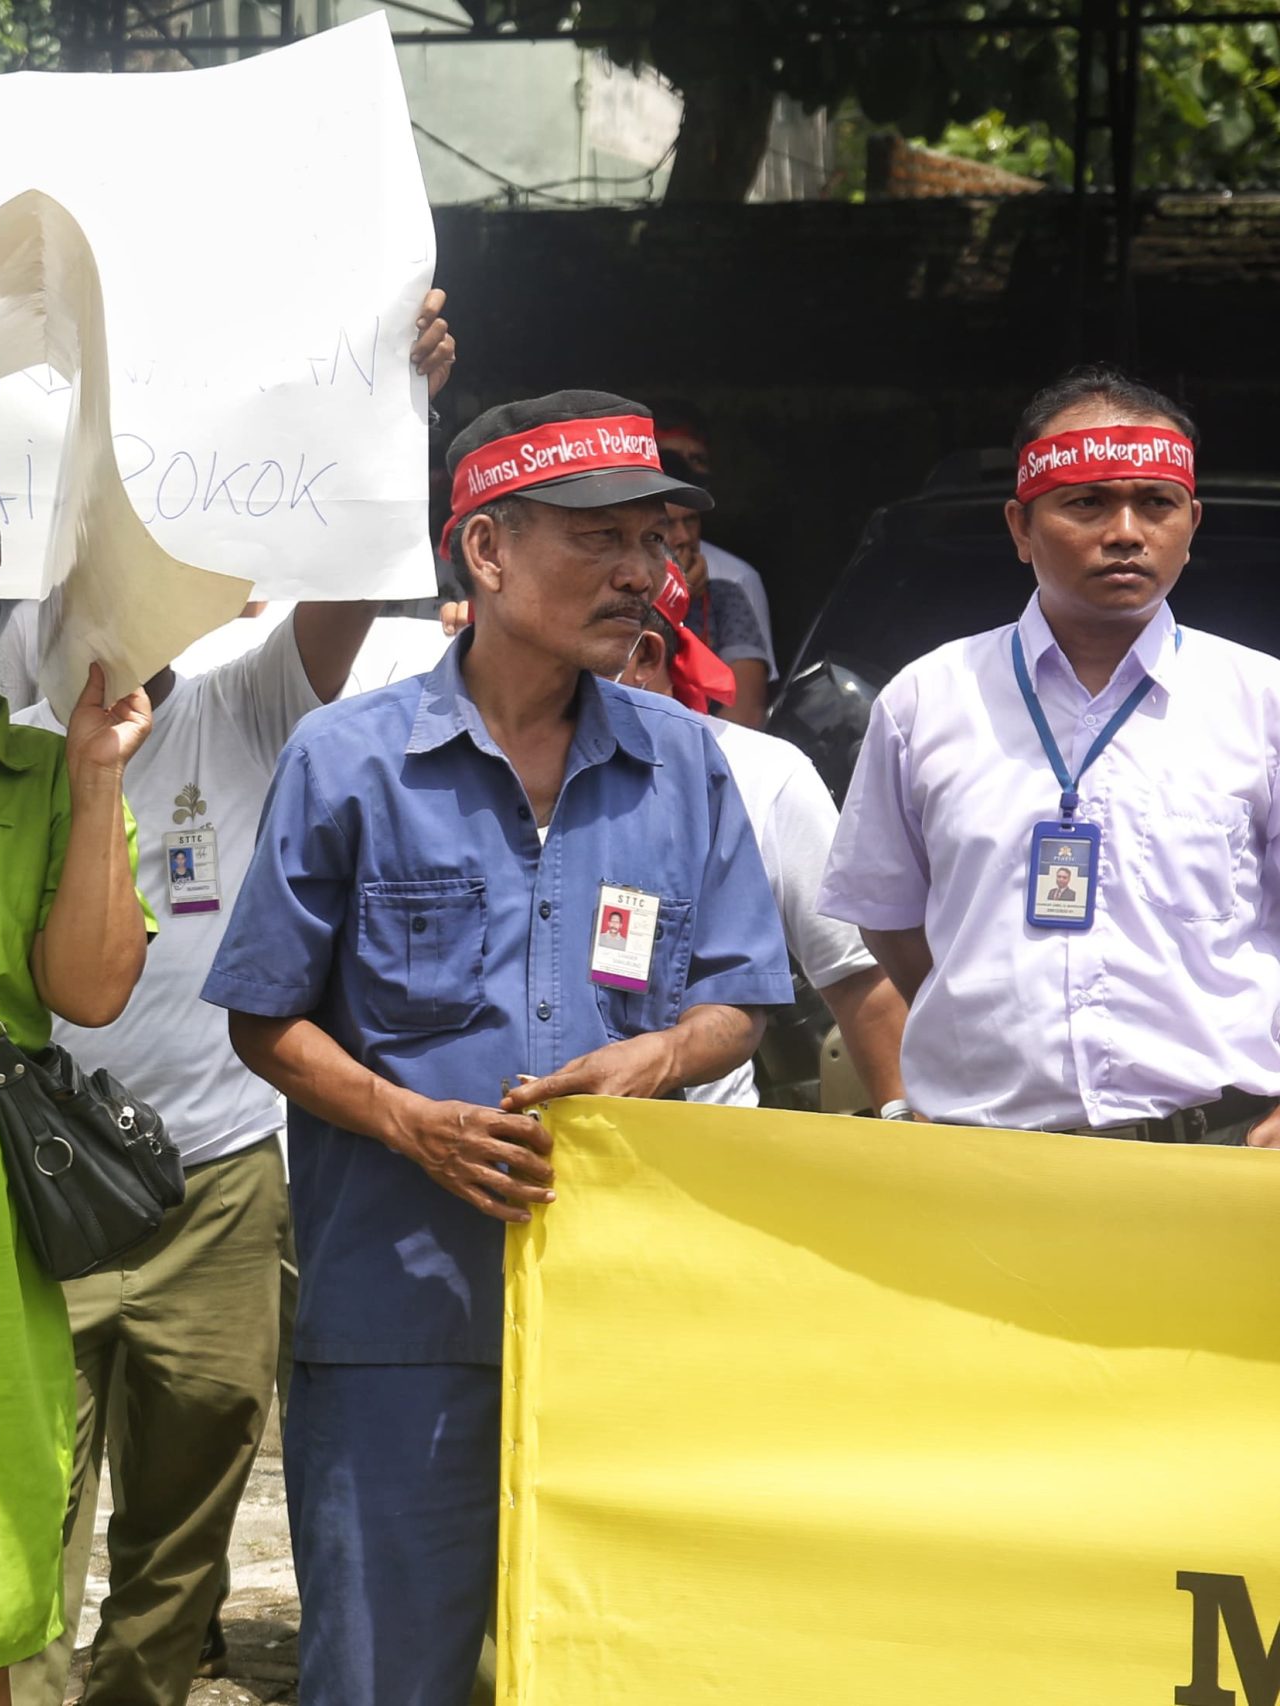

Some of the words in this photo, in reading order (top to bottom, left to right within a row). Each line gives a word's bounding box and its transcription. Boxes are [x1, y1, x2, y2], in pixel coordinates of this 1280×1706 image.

[468, 458, 519, 497] Aliansi
[520, 433, 597, 473] Serikat
[1027, 443, 1078, 478] Serikat
[617, 894, 645, 908] STTC
